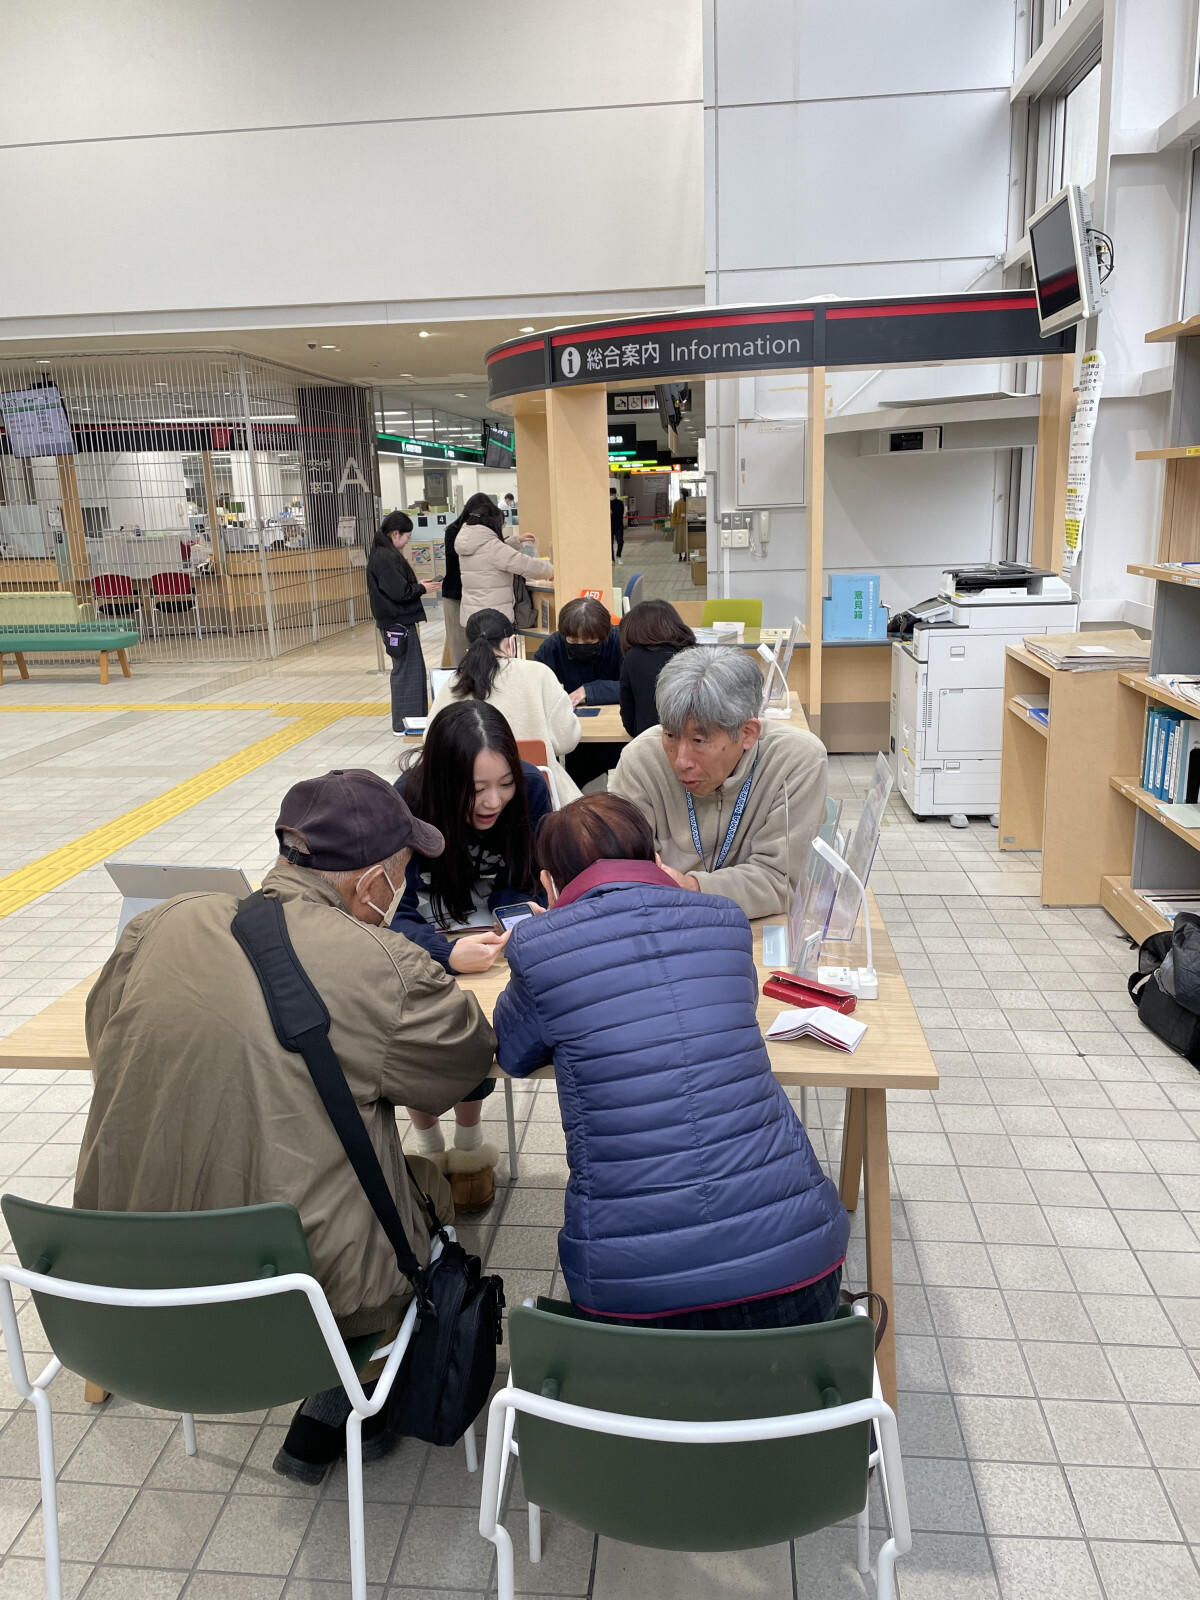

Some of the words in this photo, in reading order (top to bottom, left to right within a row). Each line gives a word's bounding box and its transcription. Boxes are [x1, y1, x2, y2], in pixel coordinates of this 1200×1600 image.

[586, 341, 660, 371] 総合案内
[670, 335, 801, 362] Information
[337, 456, 371, 493] A
[854, 590, 864, 620] 意見箱
